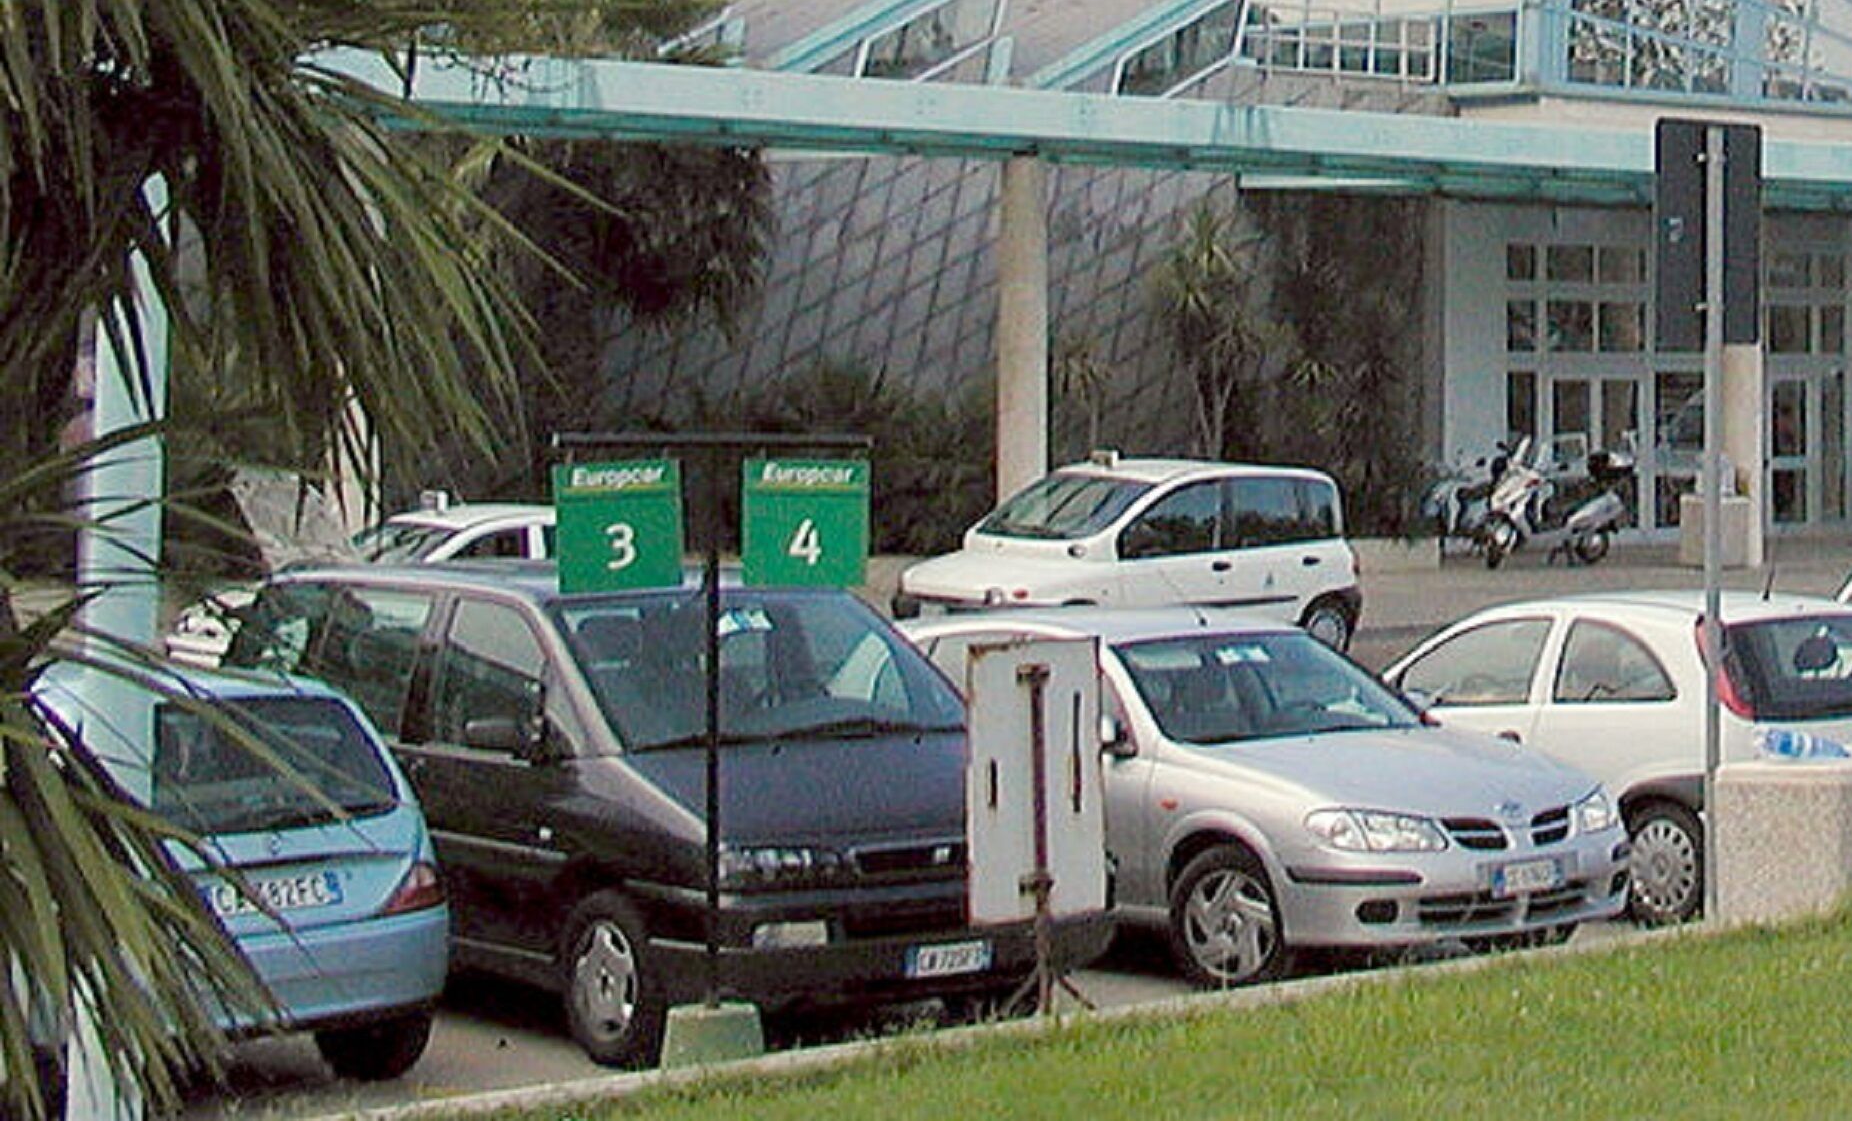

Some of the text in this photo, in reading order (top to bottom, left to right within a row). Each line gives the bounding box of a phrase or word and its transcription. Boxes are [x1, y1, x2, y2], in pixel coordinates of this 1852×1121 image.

[571, 464, 664, 489] Europcar
[762, 462, 853, 486] Europcar
[605, 522, 638, 570] 3
[788, 517, 821, 567] 4
